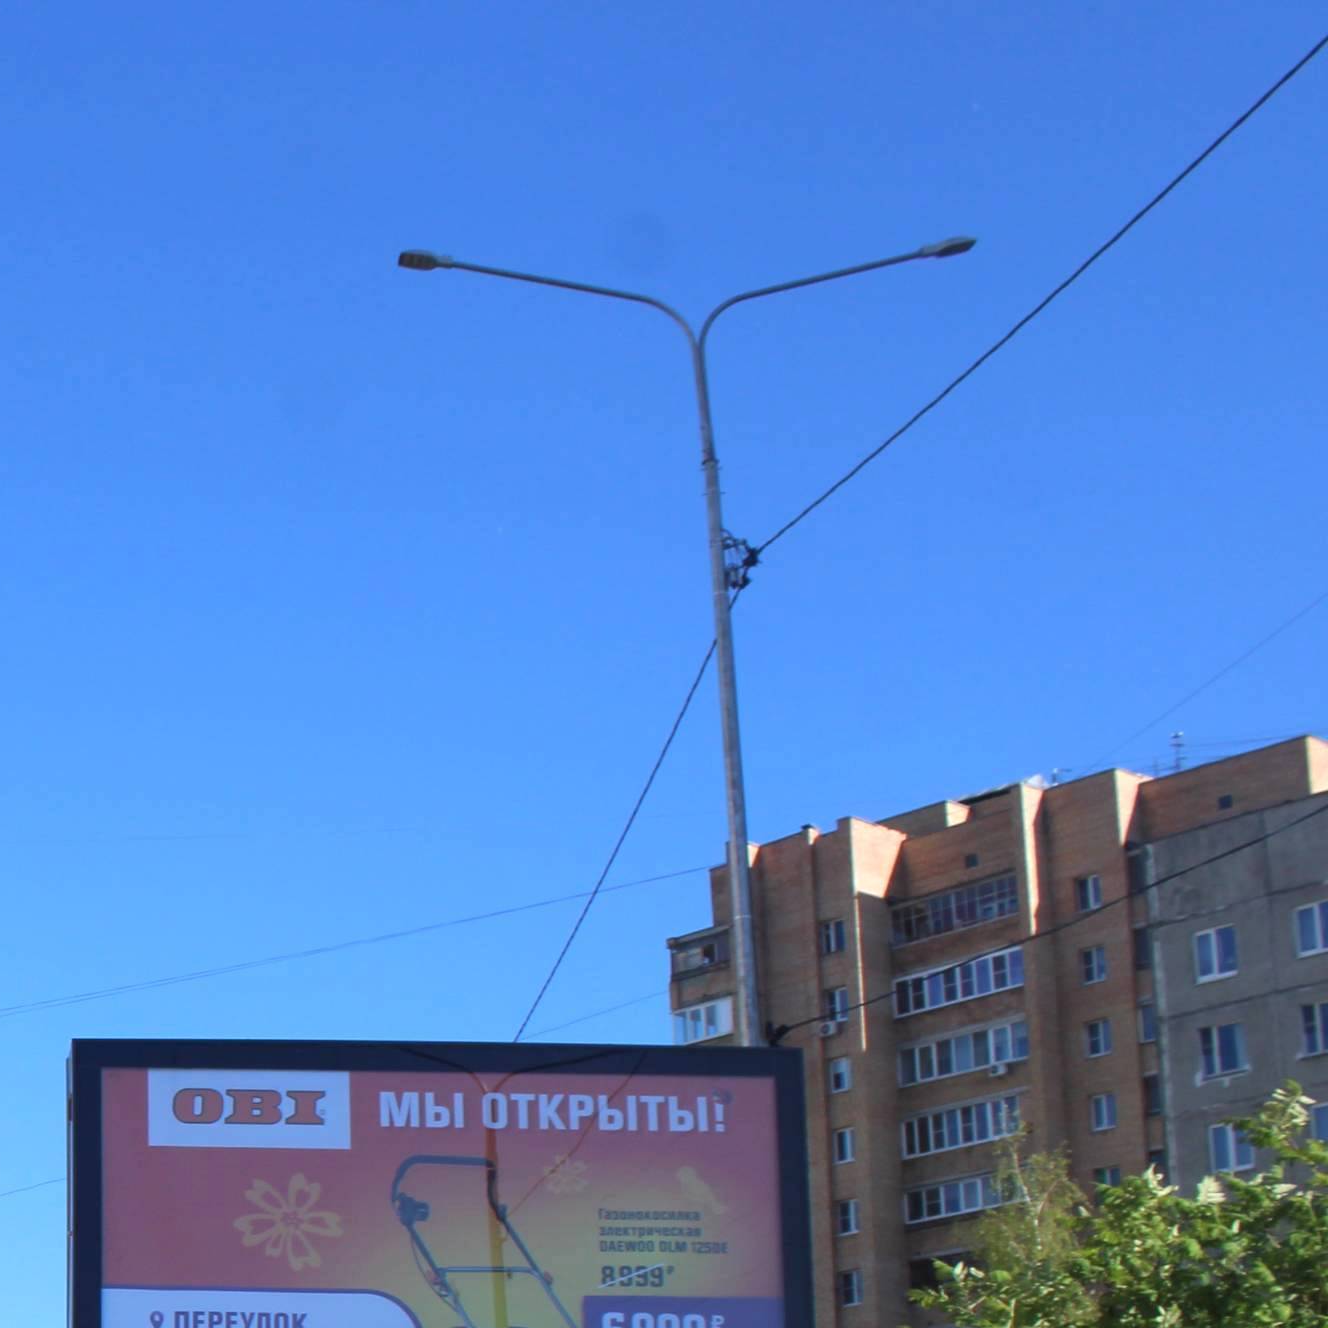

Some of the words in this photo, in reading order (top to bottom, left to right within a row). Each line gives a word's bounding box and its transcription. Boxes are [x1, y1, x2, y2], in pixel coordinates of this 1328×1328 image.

[172, 1087, 326, 1126] OBI
[378, 1090, 465, 1129] МЫ
[481, 1091, 727, 1133] ОТКРЫТЫ!
[599, 1240, 655, 1253] DAEWOO
